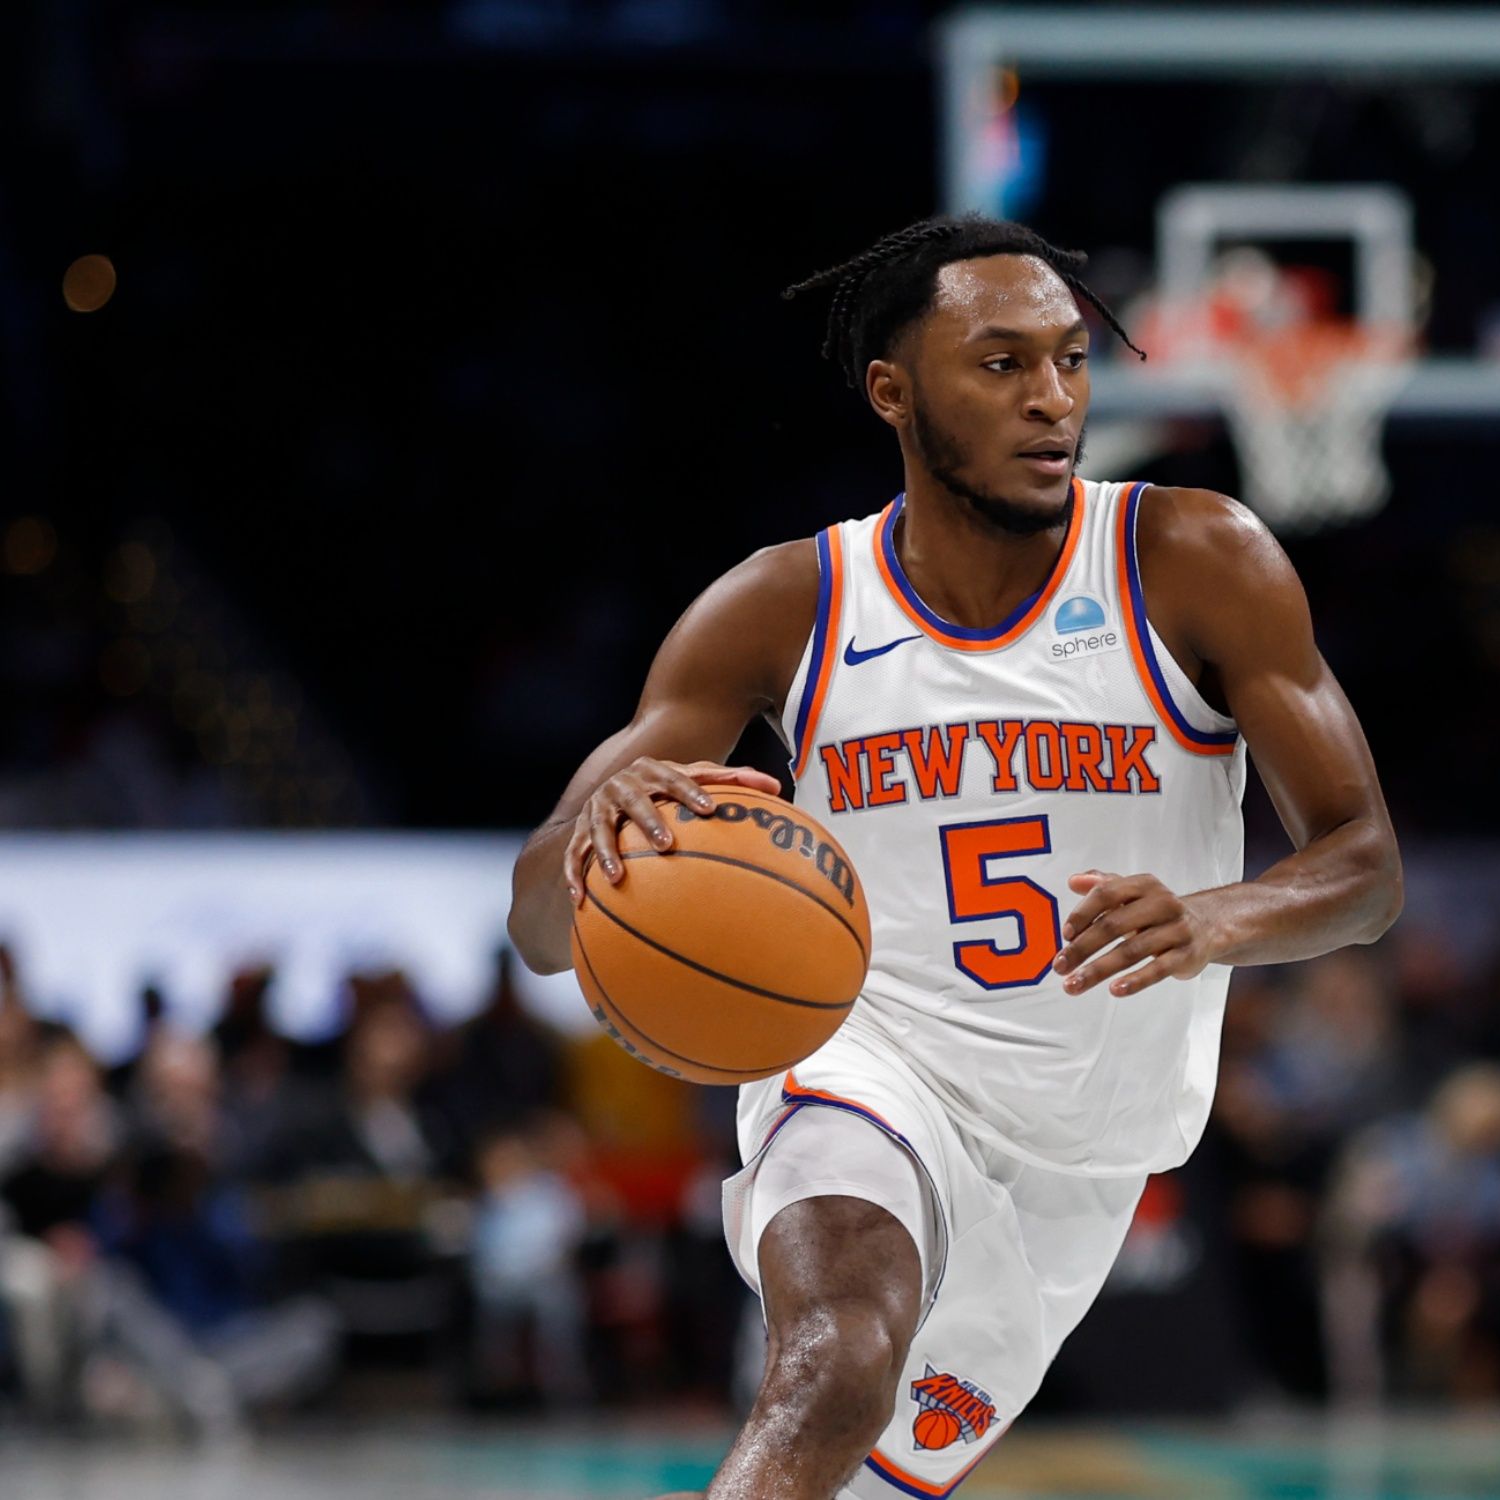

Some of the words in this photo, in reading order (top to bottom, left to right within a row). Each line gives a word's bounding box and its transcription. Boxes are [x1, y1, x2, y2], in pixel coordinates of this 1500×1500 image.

[1051, 632, 1117, 659] sphere
[820, 723, 970, 814] NEW
[976, 720, 1161, 793] YORK
[939, 814, 1063, 991] 5
[911, 1373, 996, 1438] KNICKS
